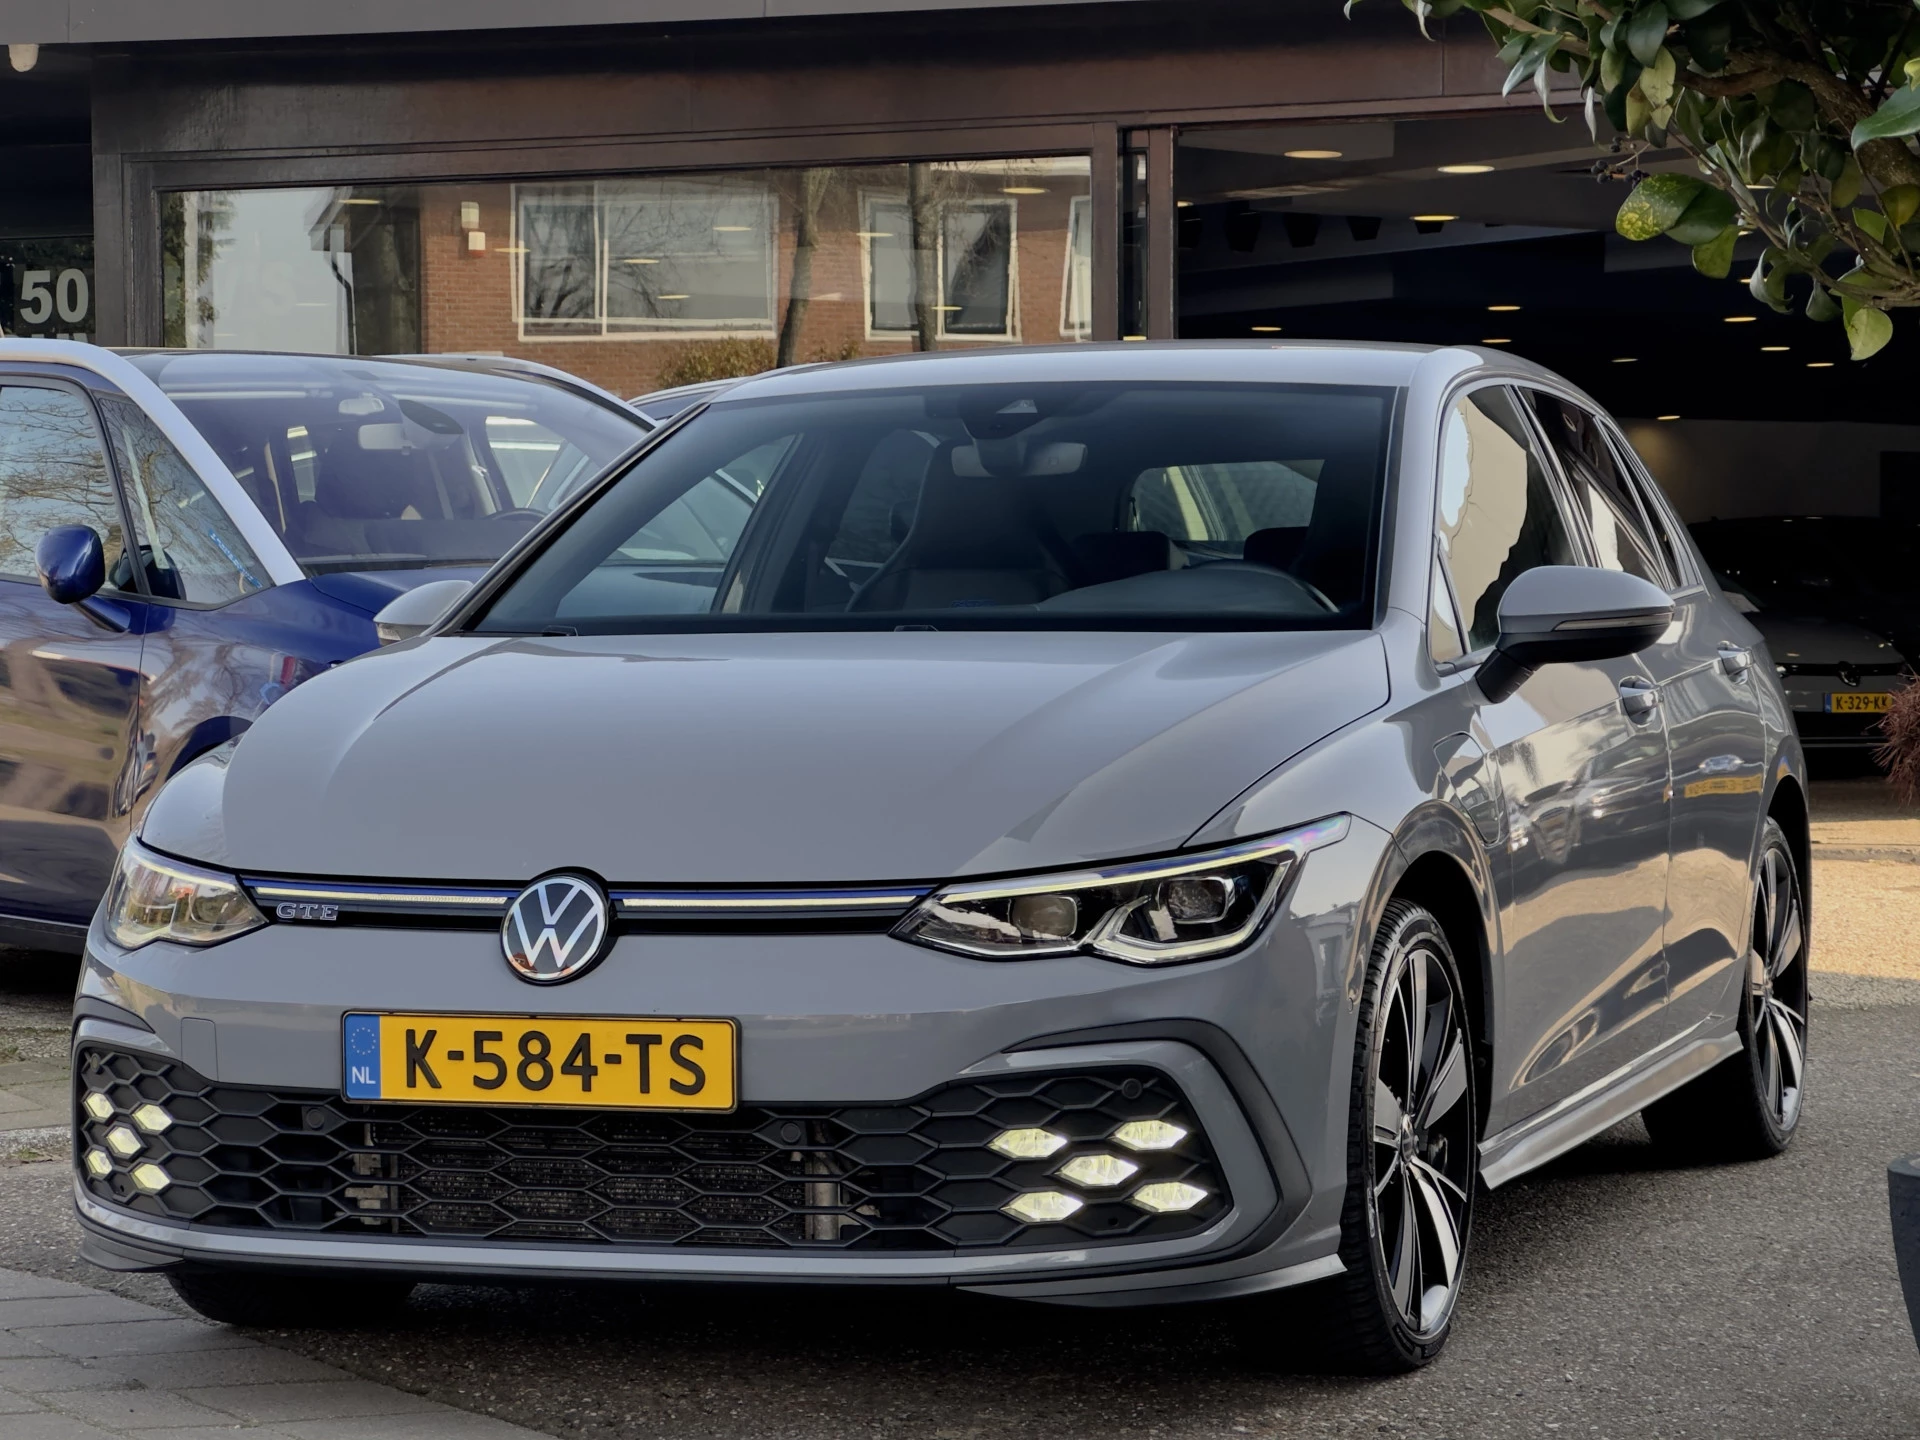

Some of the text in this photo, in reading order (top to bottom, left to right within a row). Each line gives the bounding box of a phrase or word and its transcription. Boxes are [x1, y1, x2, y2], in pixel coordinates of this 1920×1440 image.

[20, 268, 89, 324] 50
[276, 902, 338, 920] GTE
[352, 1066, 376, 1085] NL
[406, 1029, 706, 1096] K-584-TS
